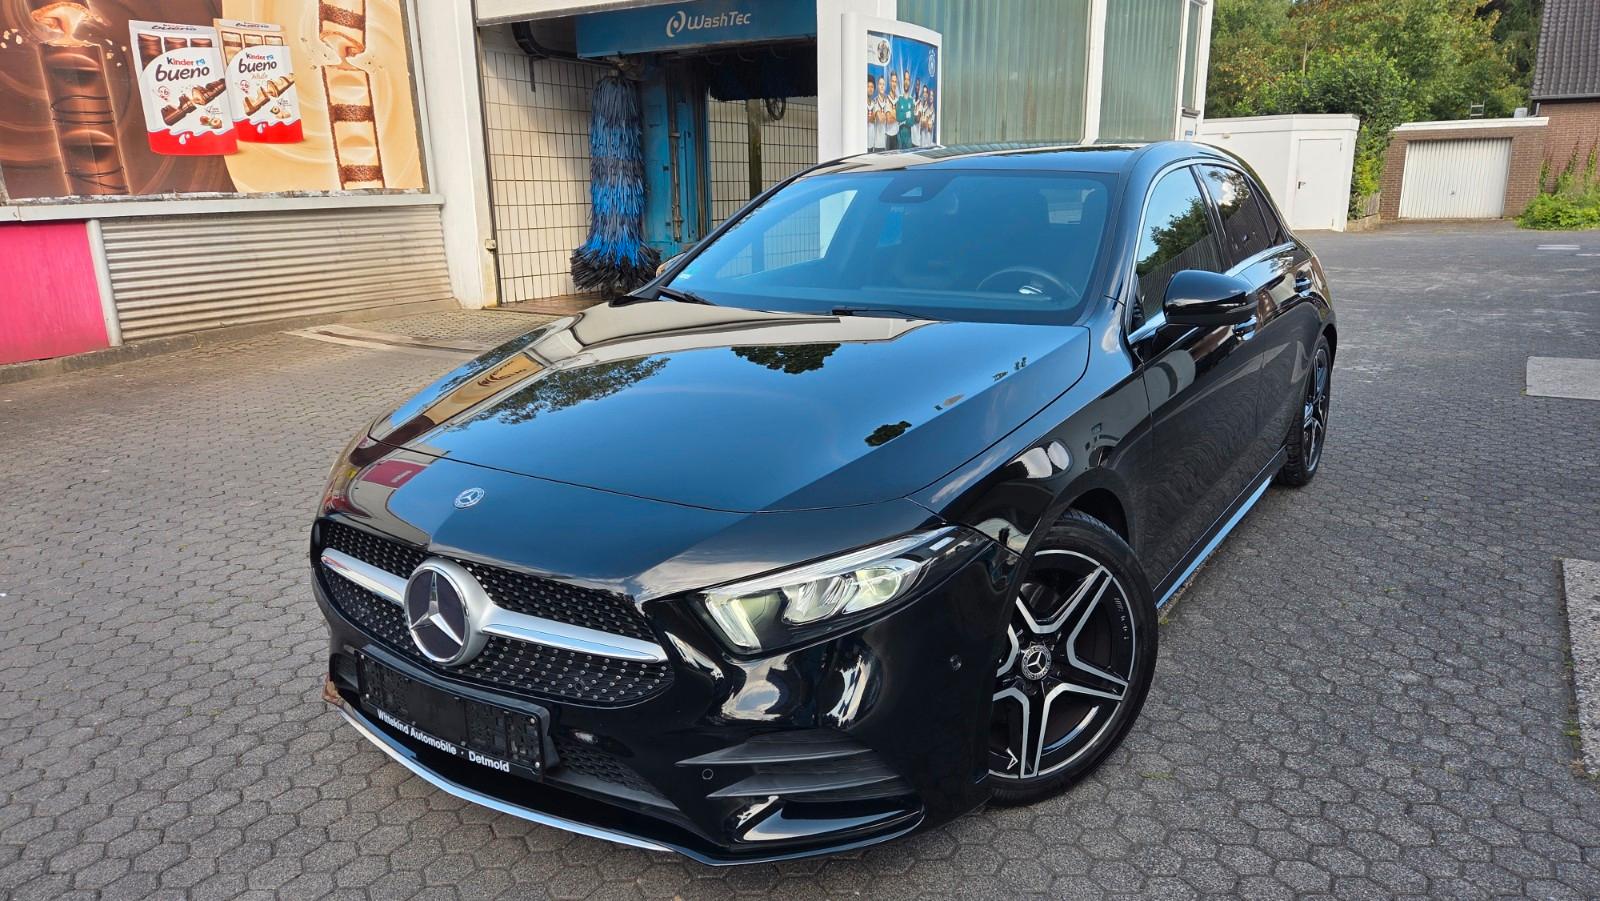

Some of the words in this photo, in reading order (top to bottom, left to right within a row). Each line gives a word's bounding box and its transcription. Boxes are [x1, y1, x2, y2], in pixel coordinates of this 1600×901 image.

[687, 11, 752, 30] WashTec
[155, 64, 210, 82] bueno
[238, 58, 277, 73] bueno
[377, 709, 409, 734] Wittekind
[410, 728, 457, 756] Automobile
[468, 750, 510, 773] Detmold
